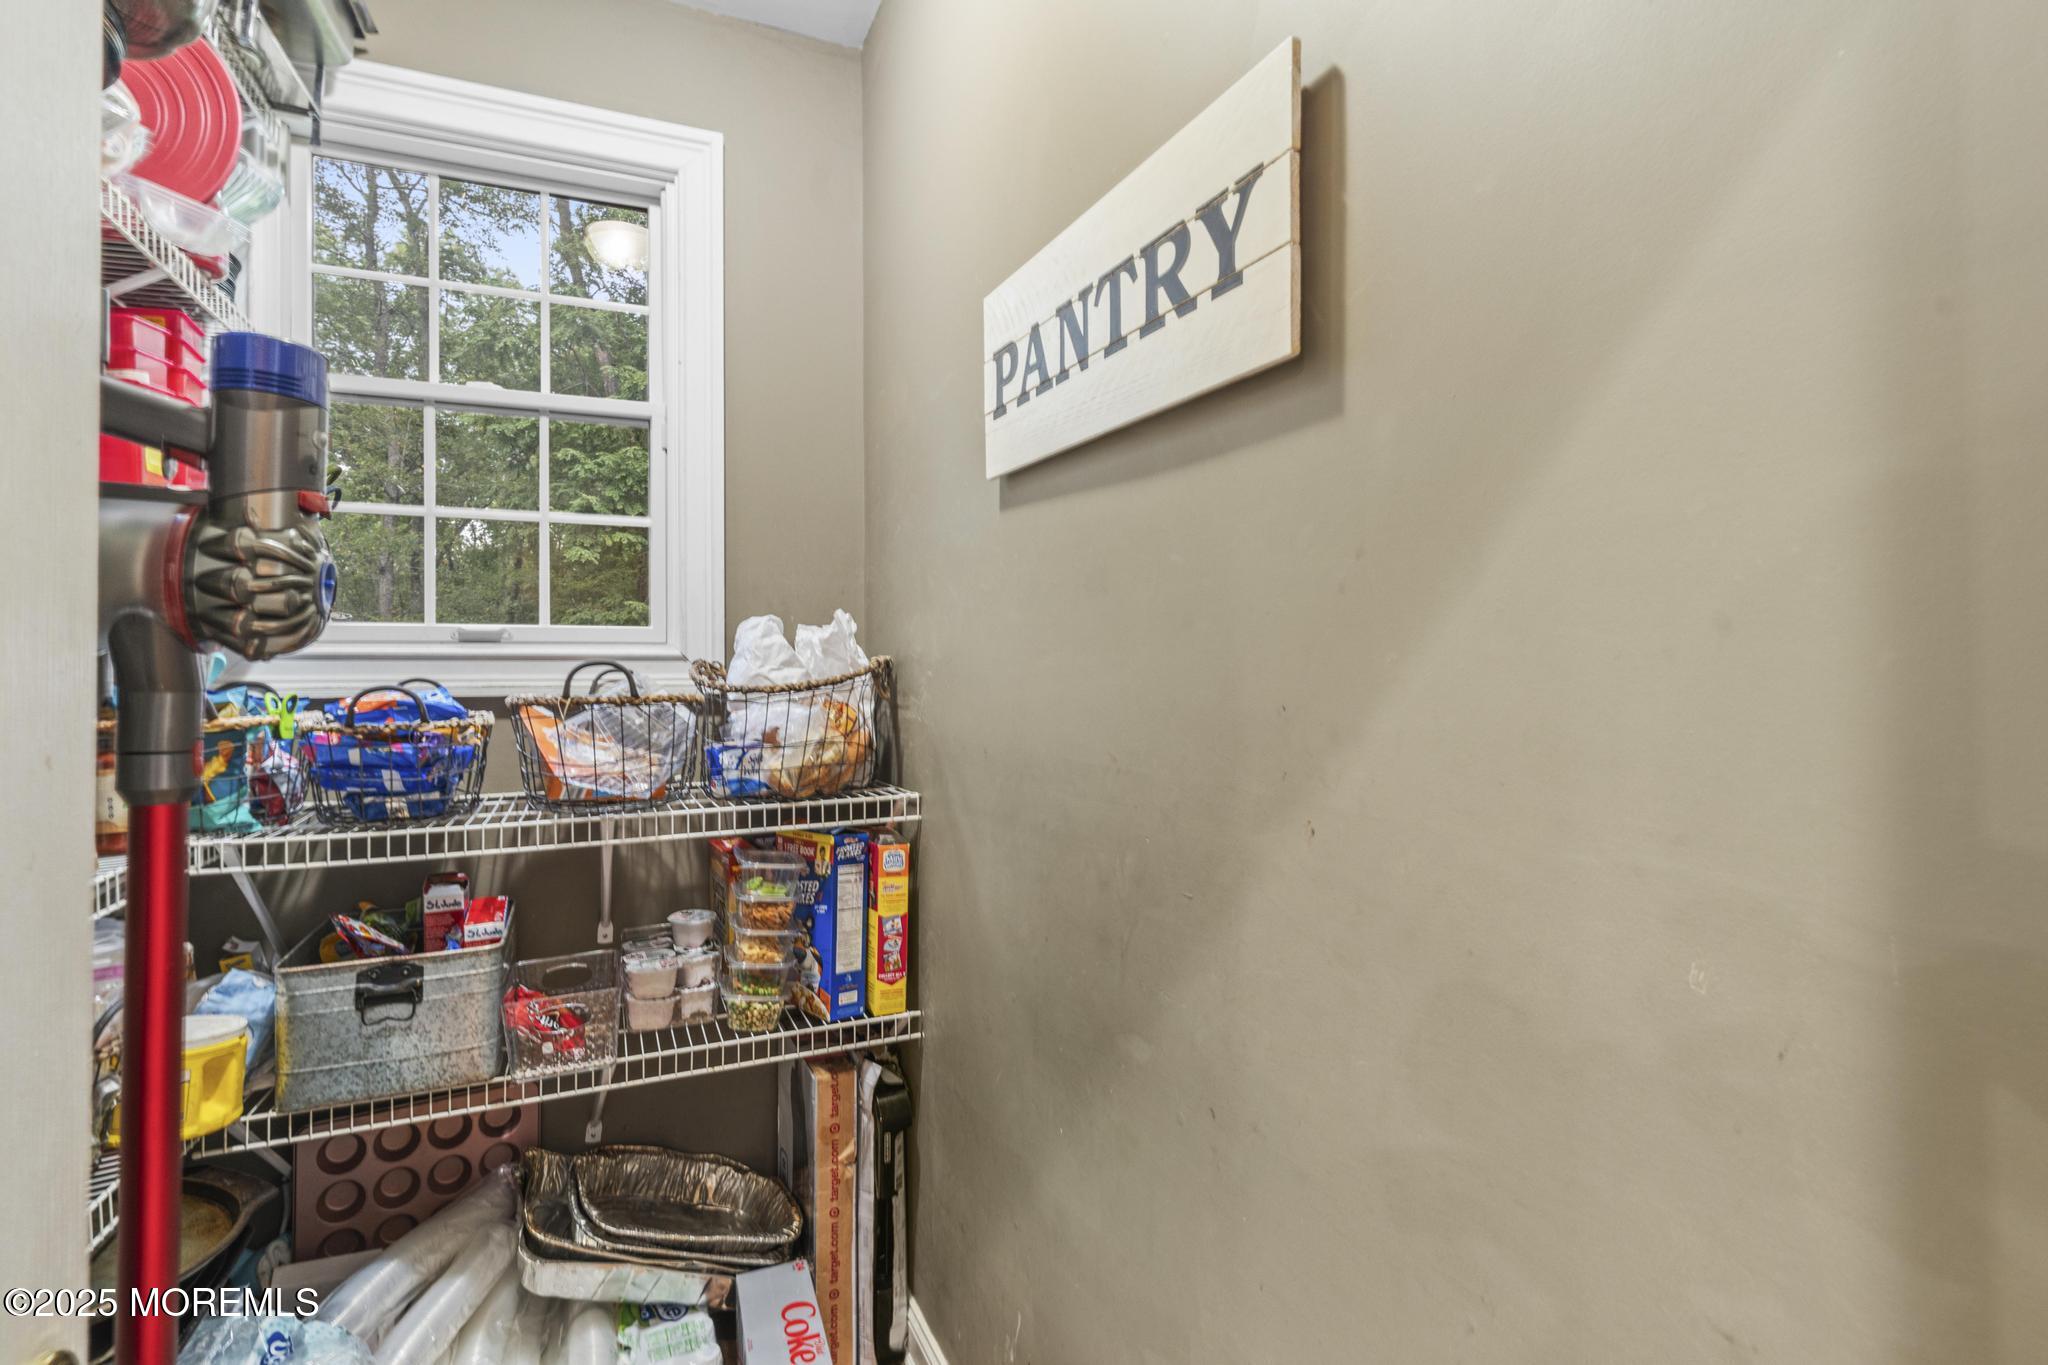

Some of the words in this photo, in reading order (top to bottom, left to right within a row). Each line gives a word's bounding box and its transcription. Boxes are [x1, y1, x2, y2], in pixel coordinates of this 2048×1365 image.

[993, 161, 1264, 420] PANTRY
[830, 1071, 840, 1118] target.c
[830, 1139, 840, 1202] target.com
[830, 1222, 840, 1284] target.com
[781, 1301, 820, 1365] Coke
